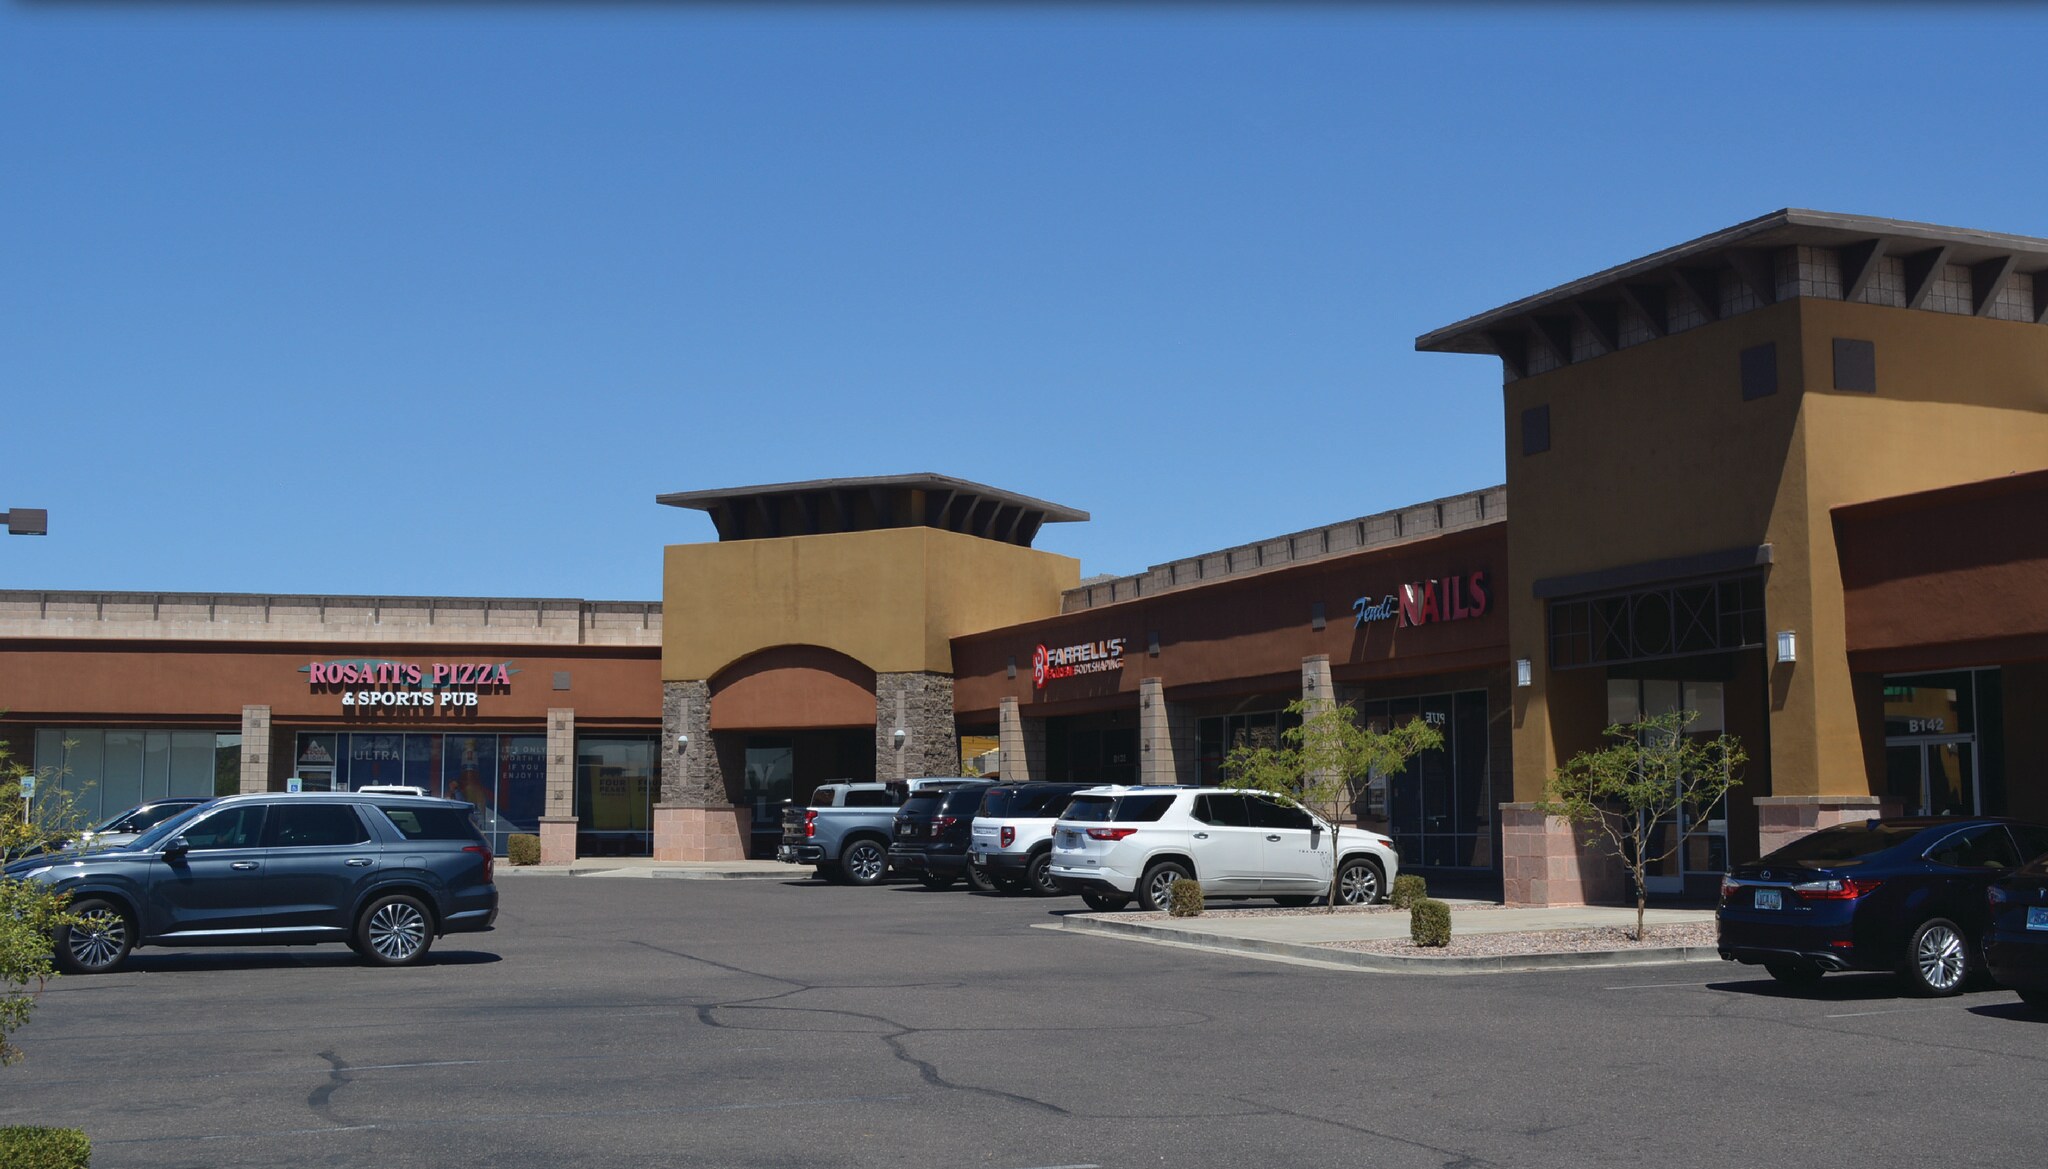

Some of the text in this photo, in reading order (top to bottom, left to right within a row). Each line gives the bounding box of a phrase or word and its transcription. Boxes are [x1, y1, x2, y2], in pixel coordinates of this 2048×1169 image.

[1353, 570, 1487, 629] Fendi NAILS
[1046, 638, 1122, 667] FARRELL'S
[310, 663, 510, 684] ROSATI'S PIZZA
[342, 691, 477, 706] & SPORTS PUB
[1909, 718, 1944, 732] B142
[354, 750, 400, 760] ULTRA
